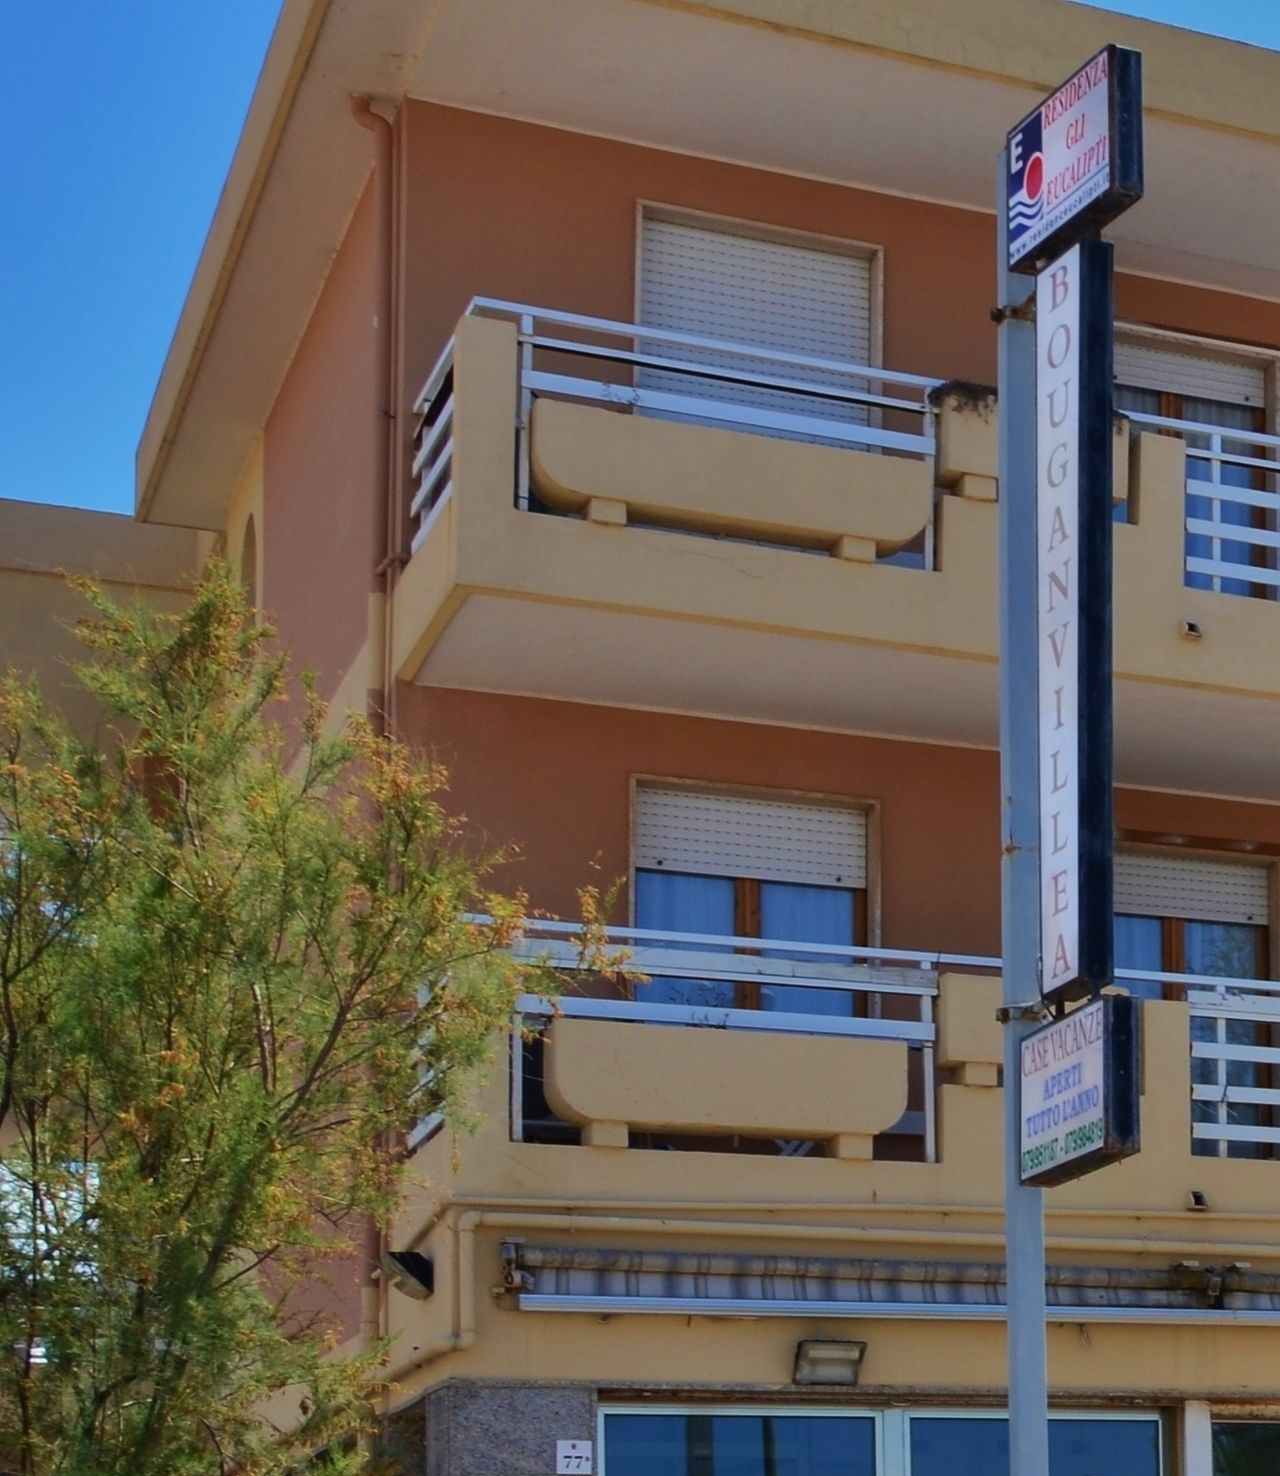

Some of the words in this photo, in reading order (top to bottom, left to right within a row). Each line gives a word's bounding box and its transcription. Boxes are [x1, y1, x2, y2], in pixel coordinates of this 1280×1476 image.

[1043, 53, 1108, 130] RESIDENZA
[1065, 112, 1085, 150] GLI
[1046, 133, 1107, 207] EUCALIPTI
[1046, 264, 1072, 980] BOUGANVILLEA
[1022, 1034, 1049, 1078] CASE
[1050, 1007, 1102, 1065] VACANZE
[1026, 1104, 1060, 1138] TUTTO
[1062, 1084, 1100, 1122] L'ANNO
[1043, 1061, 1083, 1102] APERTI
